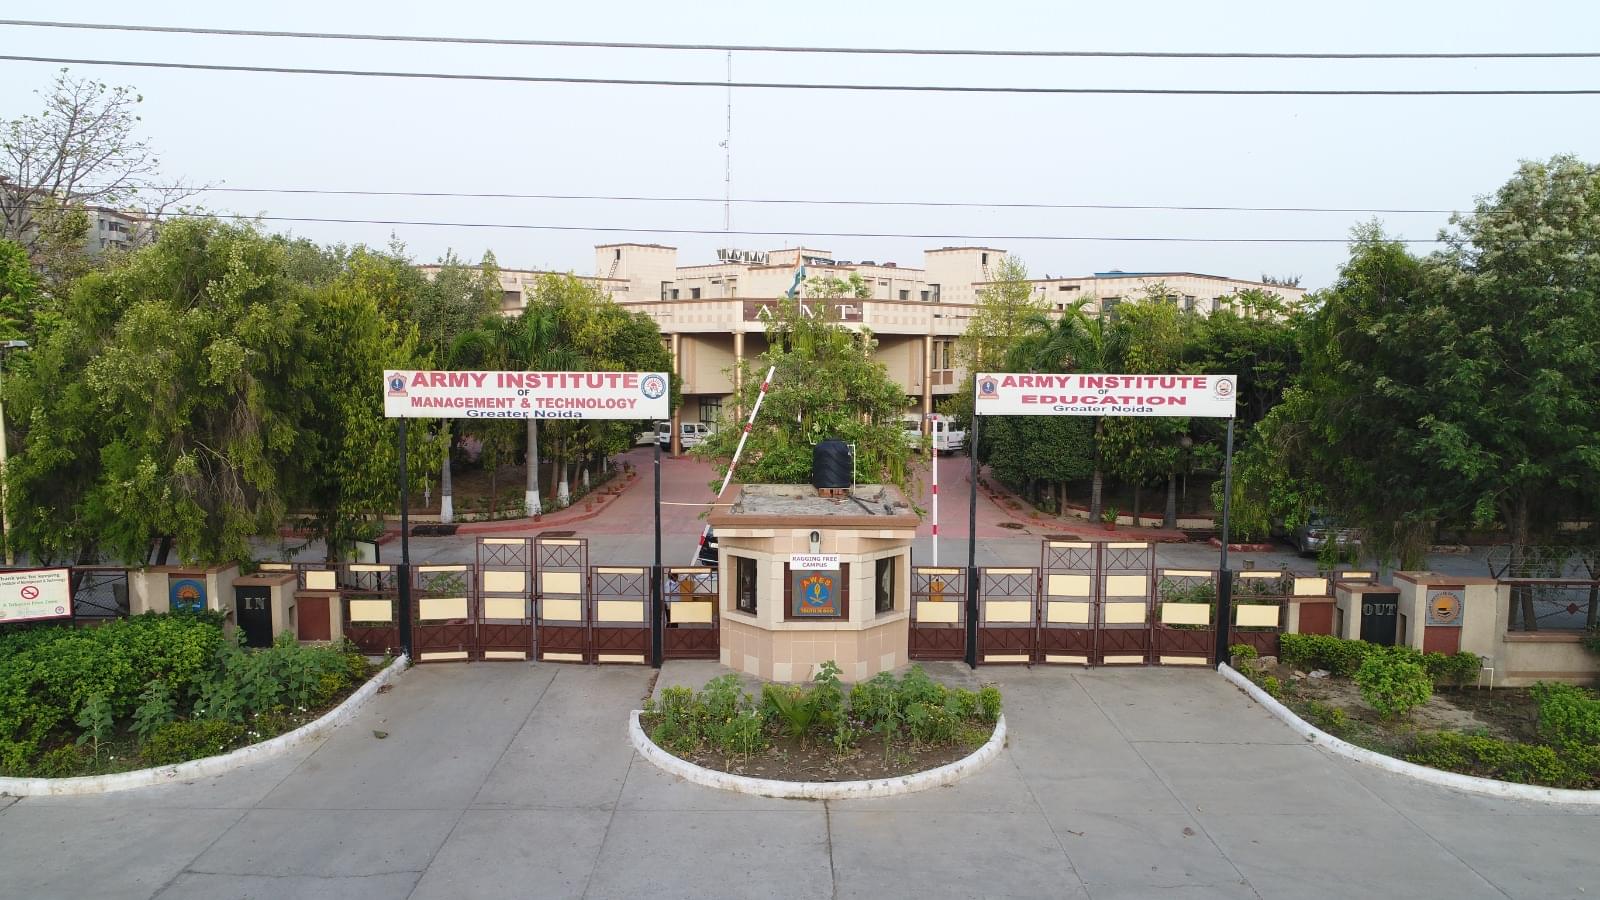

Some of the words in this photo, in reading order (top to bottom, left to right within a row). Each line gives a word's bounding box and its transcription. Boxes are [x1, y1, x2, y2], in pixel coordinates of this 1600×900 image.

[410, 372, 489, 388] ARMY
[497, 372, 639, 389] INSTITUTE
[1001, 375, 1076, 389] ARMY
[1079, 375, 1207, 389] INSTITUTE
[517, 389, 531, 397] OF
[410, 397, 521, 409] MANAGEMENT
[520, 397, 531, 409] &
[535, 397, 638, 409] TECHNOLOGY
[1021, 395, 1187, 405] EDUCATION
[466, 409, 530, 419] Greater
[534, 409, 583, 419] Noida
[1053, 405, 1106, 413] Greater
[1111, 405, 1154, 413] Noida
[243, 597, 267, 610] IN
[1363, 603, 1397, 616] OUT
